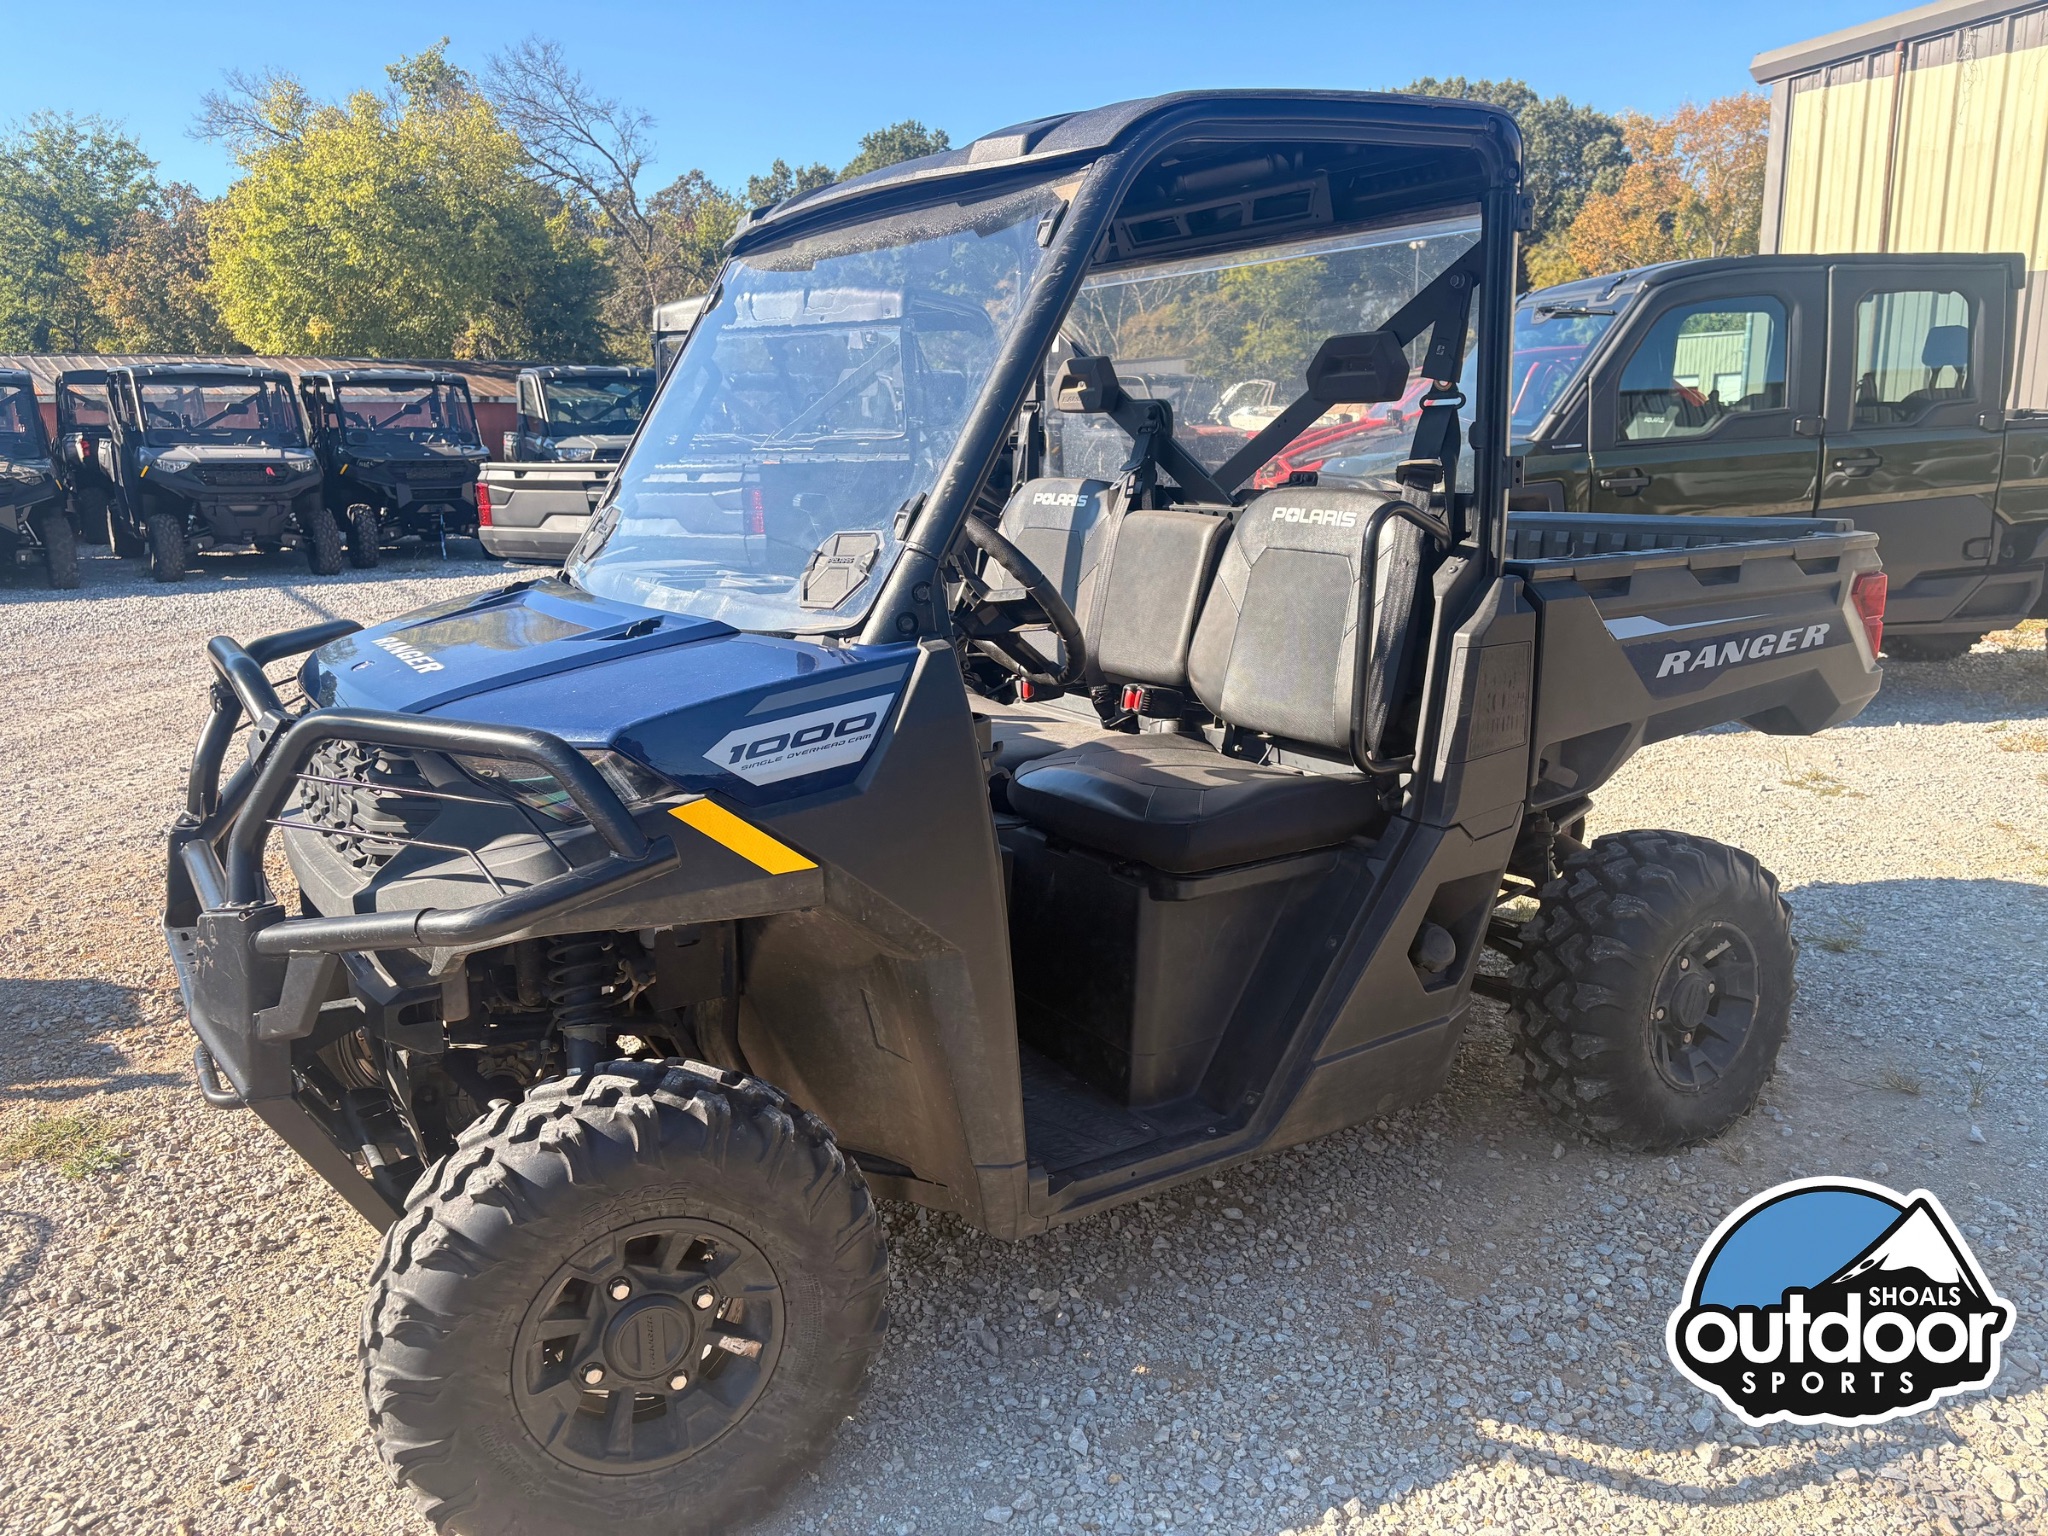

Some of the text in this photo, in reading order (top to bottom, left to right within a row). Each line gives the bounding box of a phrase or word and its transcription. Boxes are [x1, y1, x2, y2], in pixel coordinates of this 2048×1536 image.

[1033, 492, 1088, 507] POLARIS
[1271, 507, 1358, 528] POLARIS
[371, 636, 445, 674] RANGER
[1655, 623, 1830, 678] RANGER
[728, 712, 877, 765] 1000
[741, 733, 872, 771] SINGLE OVERHEAD CAM
